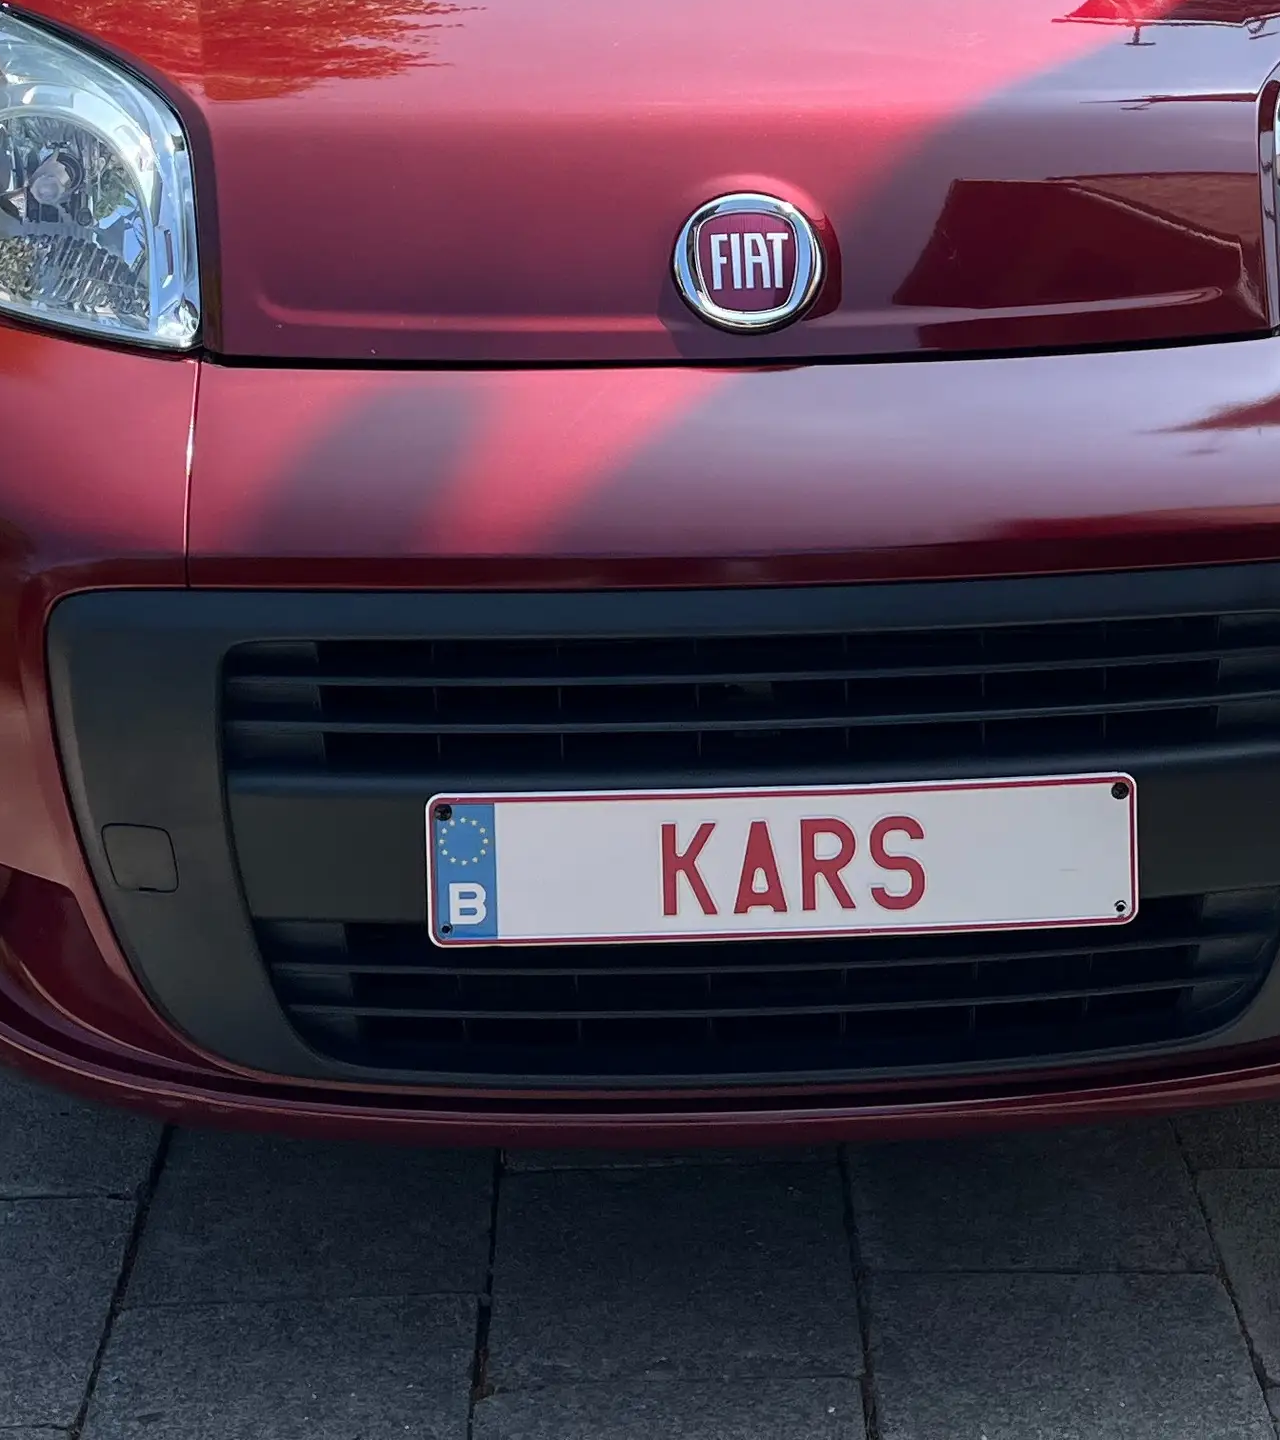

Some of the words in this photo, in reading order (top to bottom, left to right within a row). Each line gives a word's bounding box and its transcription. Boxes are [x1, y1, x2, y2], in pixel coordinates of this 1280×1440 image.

[710, 232, 789, 290] FIAT
[448, 881, 488, 926] B
[660, 814, 926, 917] KARS
